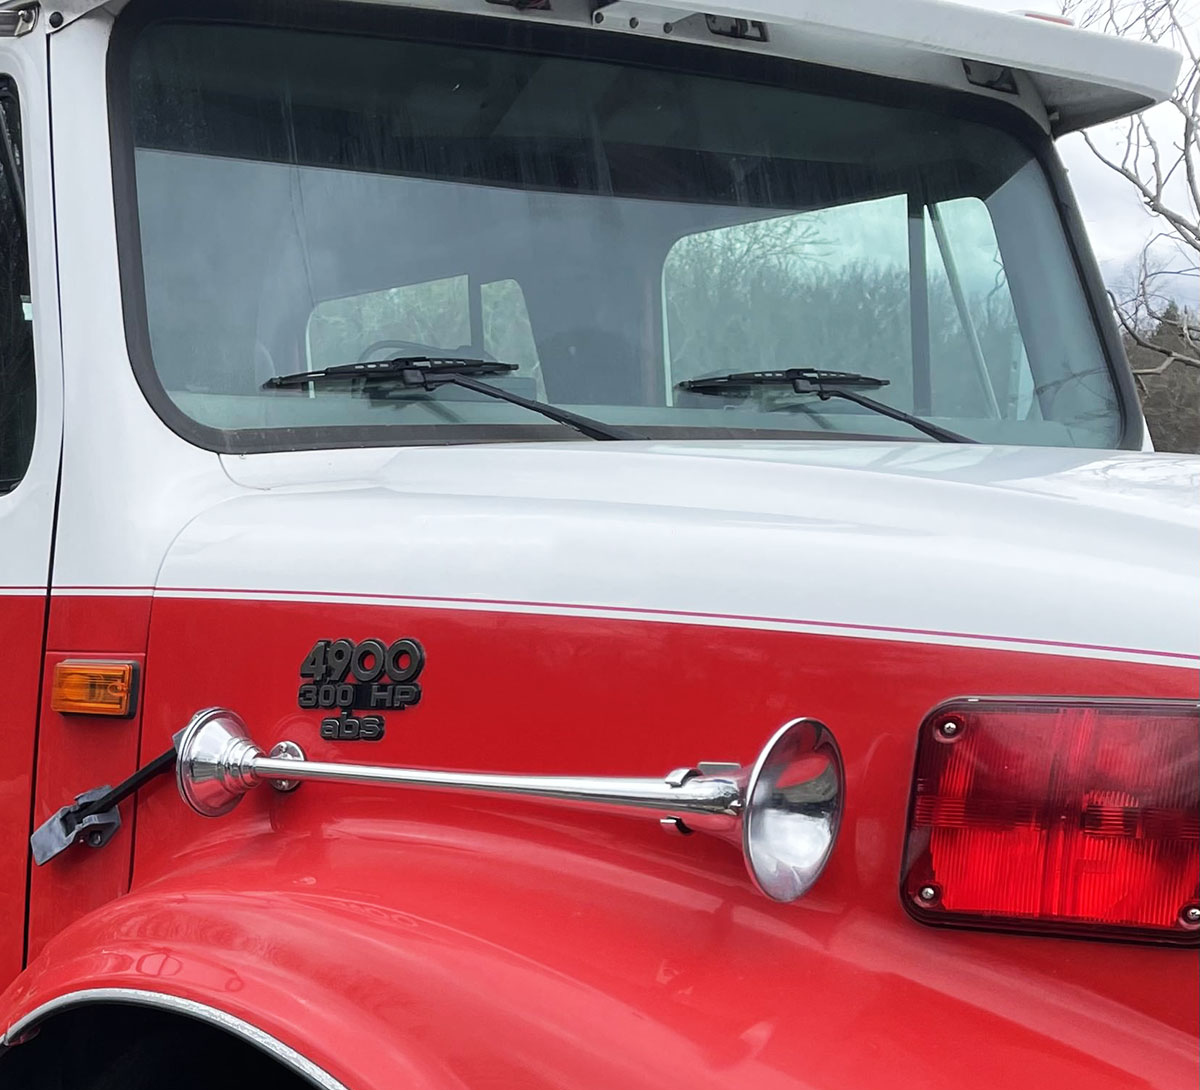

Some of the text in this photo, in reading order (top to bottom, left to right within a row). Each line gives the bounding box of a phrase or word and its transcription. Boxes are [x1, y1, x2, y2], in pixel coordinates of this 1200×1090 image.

[300, 638, 424, 683] 4900
[298, 683, 421, 709] 300 HP
[320, 711, 384, 740] abs
